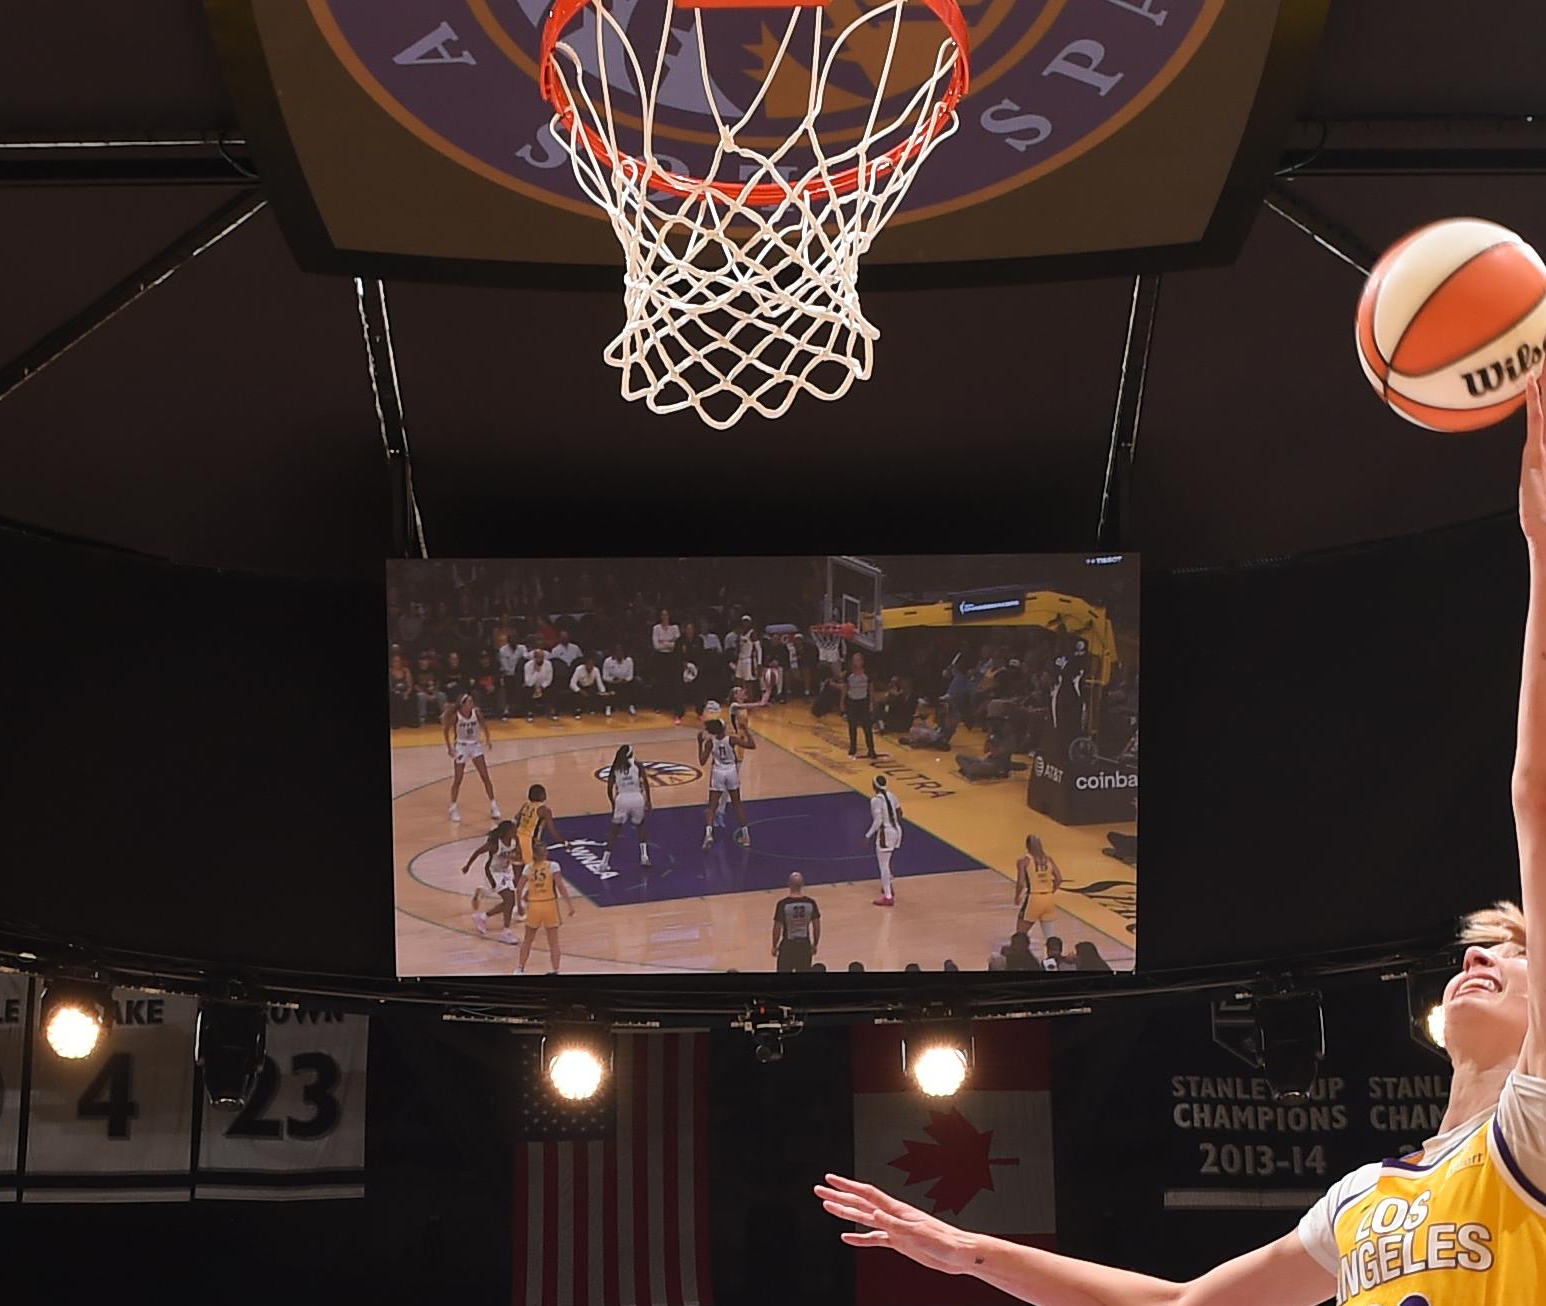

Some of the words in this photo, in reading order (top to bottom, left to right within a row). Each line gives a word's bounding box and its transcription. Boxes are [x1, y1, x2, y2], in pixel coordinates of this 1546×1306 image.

[1075, 770, 1138, 791] coinba
[76, 1052, 139, 1141] 4
[224, 1052, 342, 1141] 23
[1368, 1077, 1450, 1098] STANL
[1172, 1104, 1348, 1131] CHAMPIONS
[1198, 1143, 1327, 1177] 2013-14
[1355, 1190, 1432, 1243] LOS
